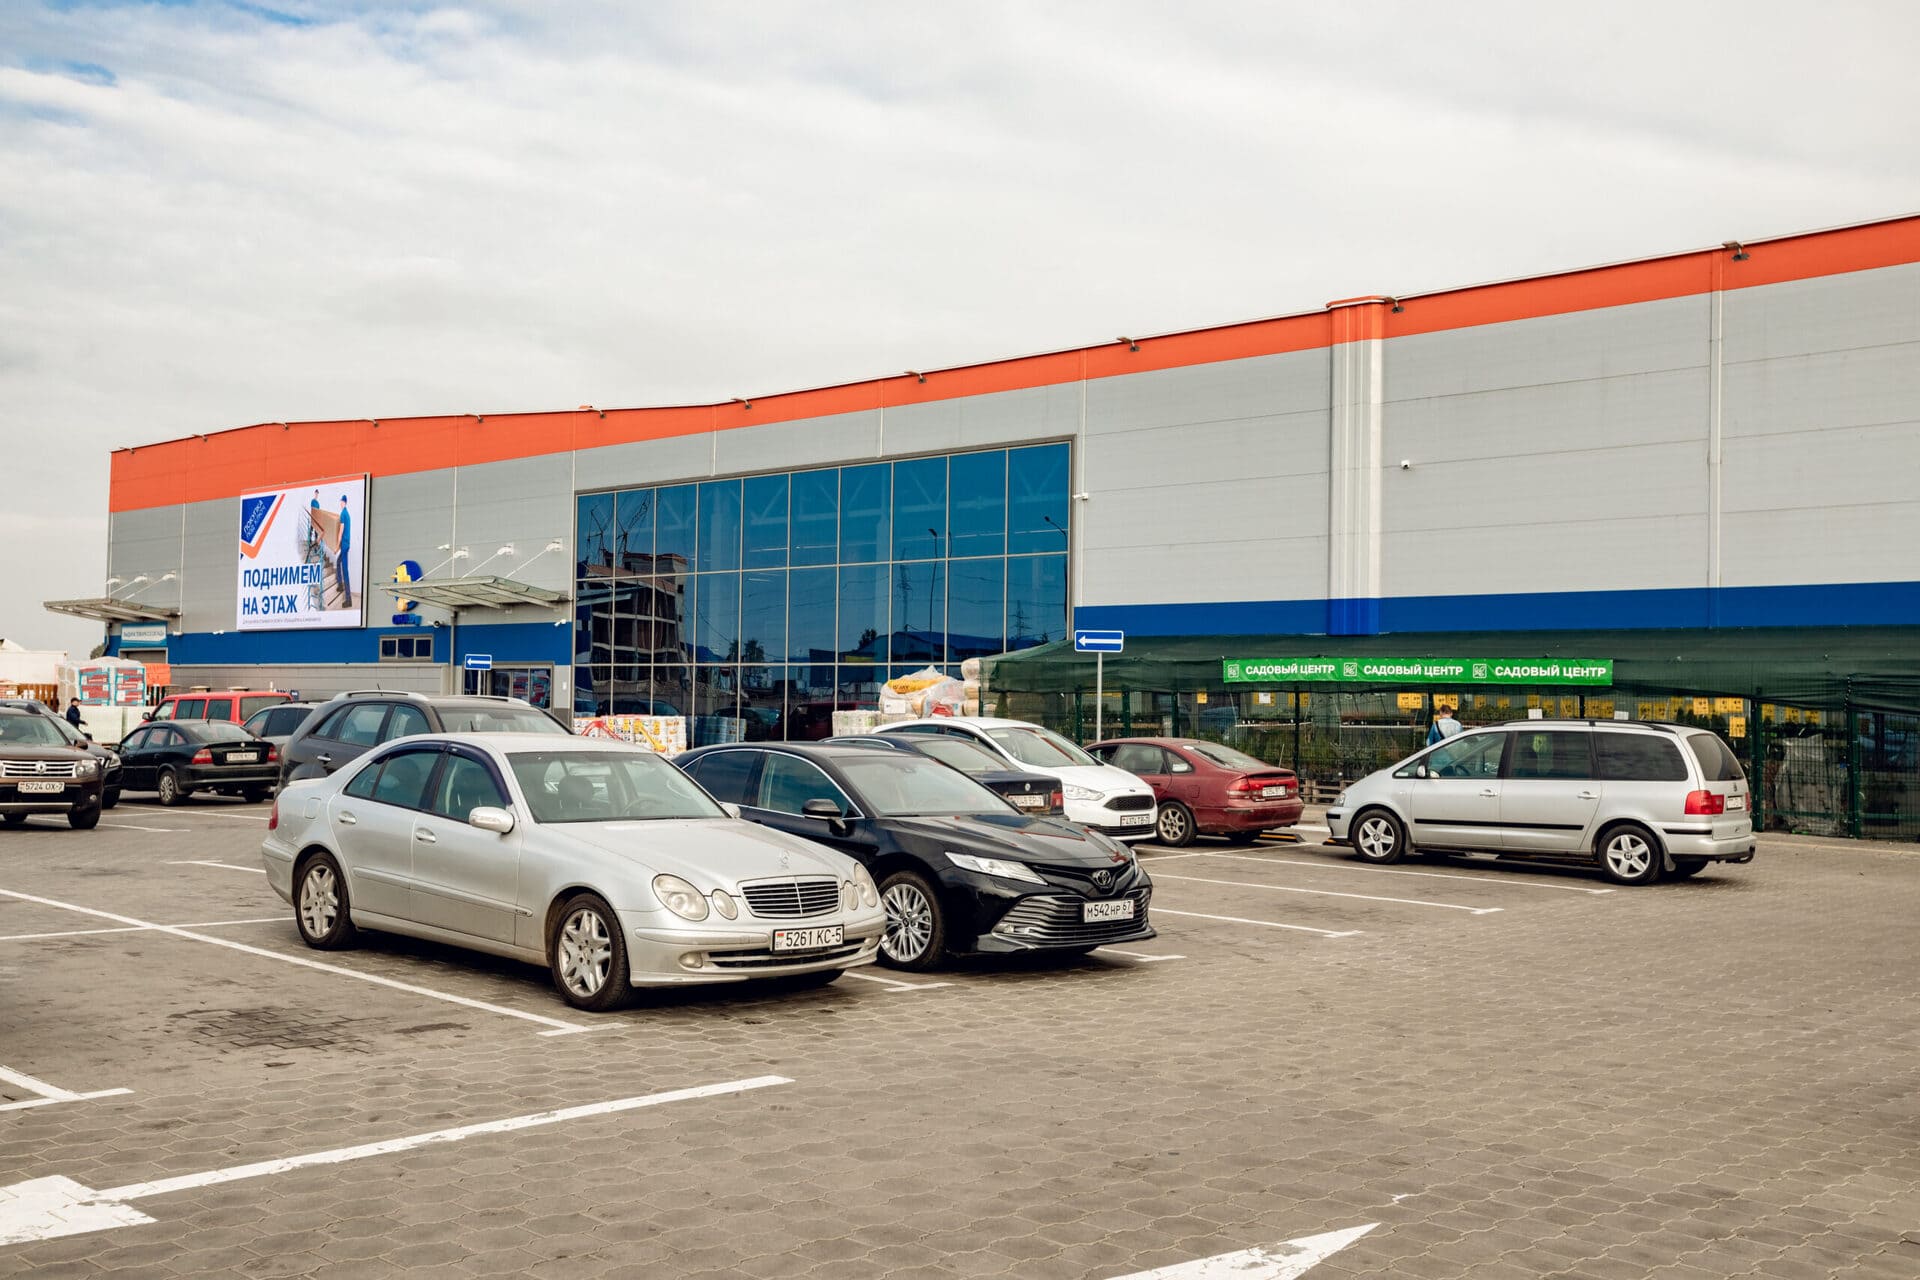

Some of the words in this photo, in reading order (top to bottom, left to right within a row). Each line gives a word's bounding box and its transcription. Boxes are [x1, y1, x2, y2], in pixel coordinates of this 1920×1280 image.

[243, 565, 321, 590] ПОДНИМЕМ
[242, 597, 257, 615] НА
[261, 594, 298, 614] ЭТАЖ
[1245, 663, 1298, 676] САДОВЫЙ
[1300, 664, 1335, 675] ЦЕНТР
[1363, 664, 1422, 676] САДОВЫЙ
[1424, 665, 1464, 677] ЦЕНТР
[1495, 665, 1560, 677] САДОВЫЙ
[1563, 666, 1607, 679] ЦЕНТР
[25, 783, 43, 791] 5724
[786, 931, 813, 947] 5261
[816, 928, 842, 945] KC-5
